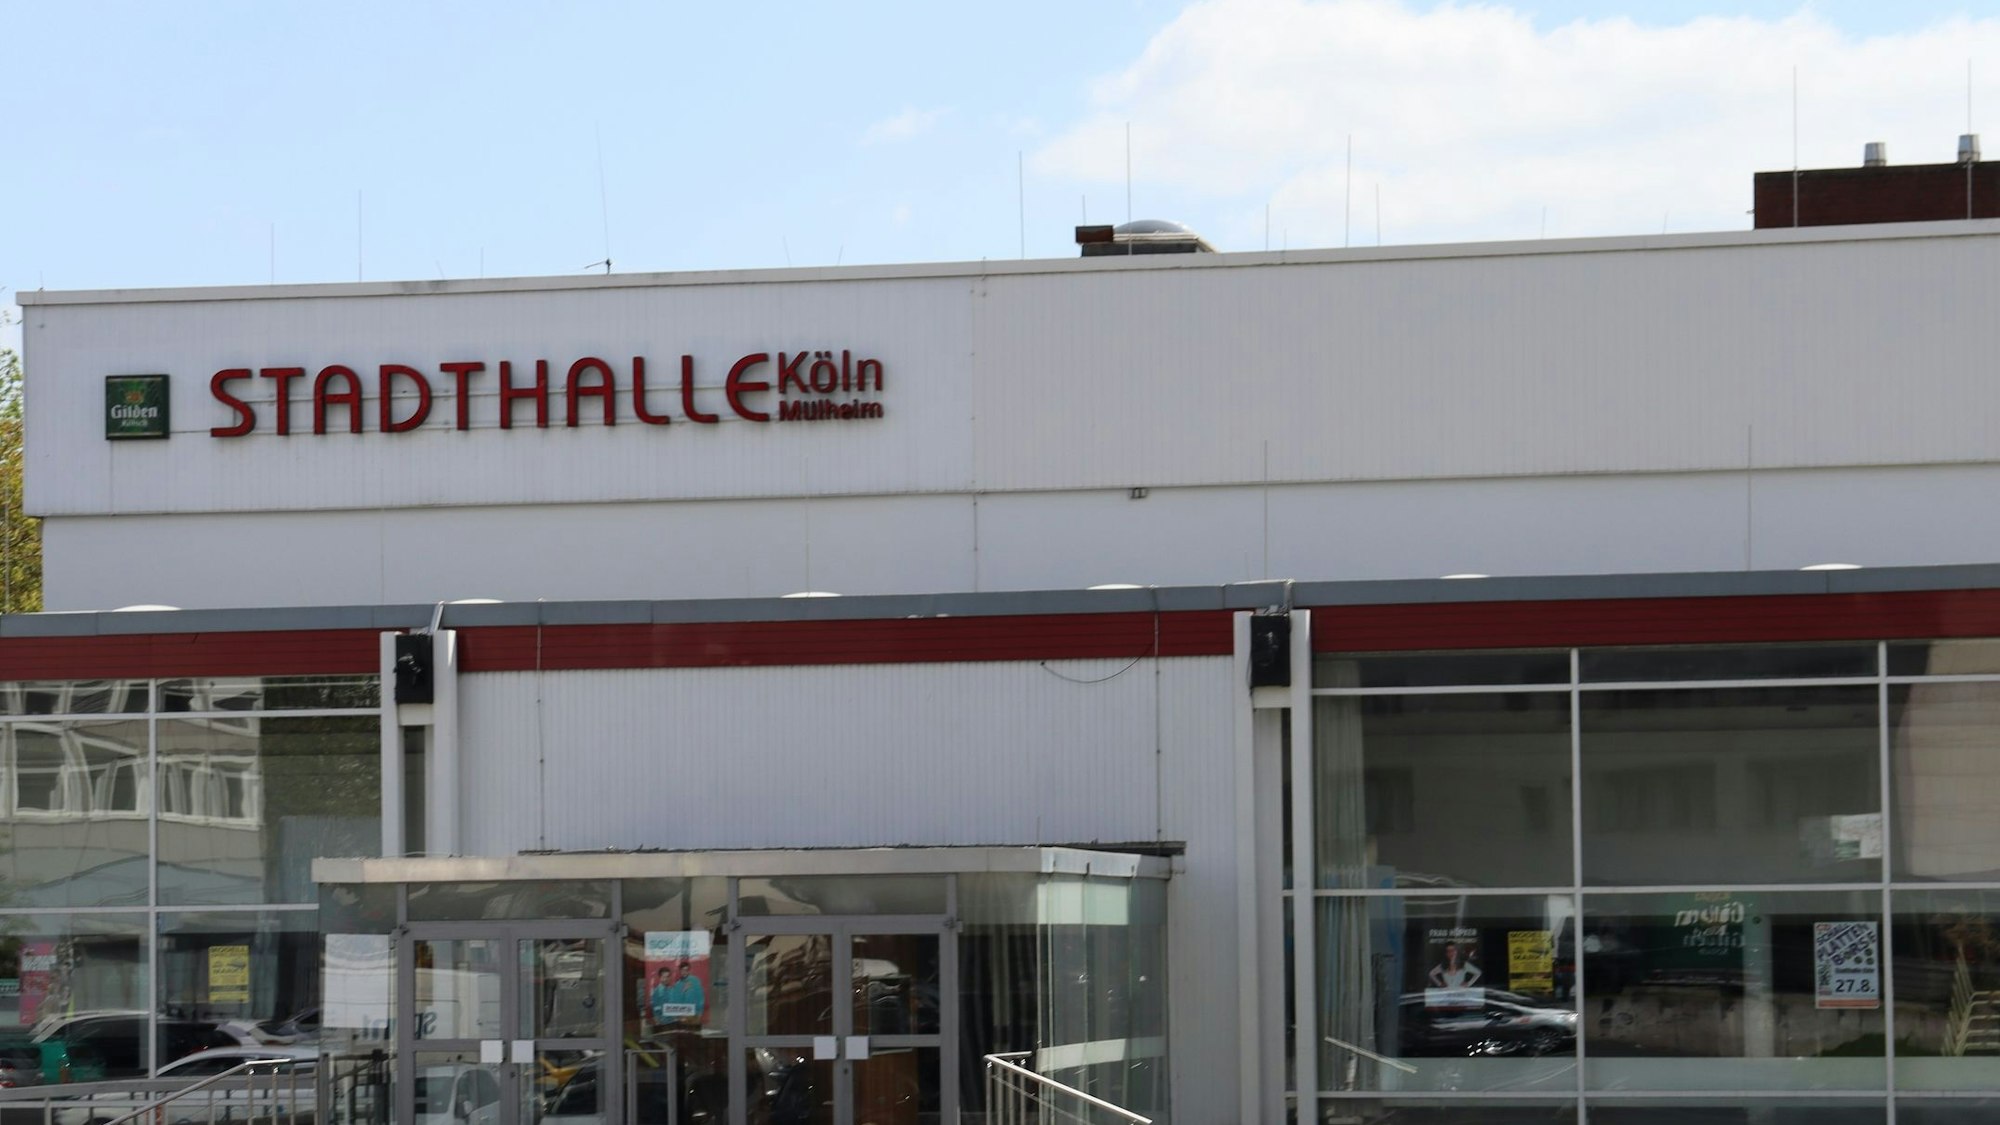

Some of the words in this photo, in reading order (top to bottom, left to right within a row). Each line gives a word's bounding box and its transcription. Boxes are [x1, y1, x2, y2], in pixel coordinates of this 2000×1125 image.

[210, 352, 770, 438] STADTHALLE
[778, 350, 884, 394] Köln
[111, 404, 159, 419] Gilden
[779, 399, 884, 421] Mülheim
[1835, 979, 1875, 993] 27.8.
